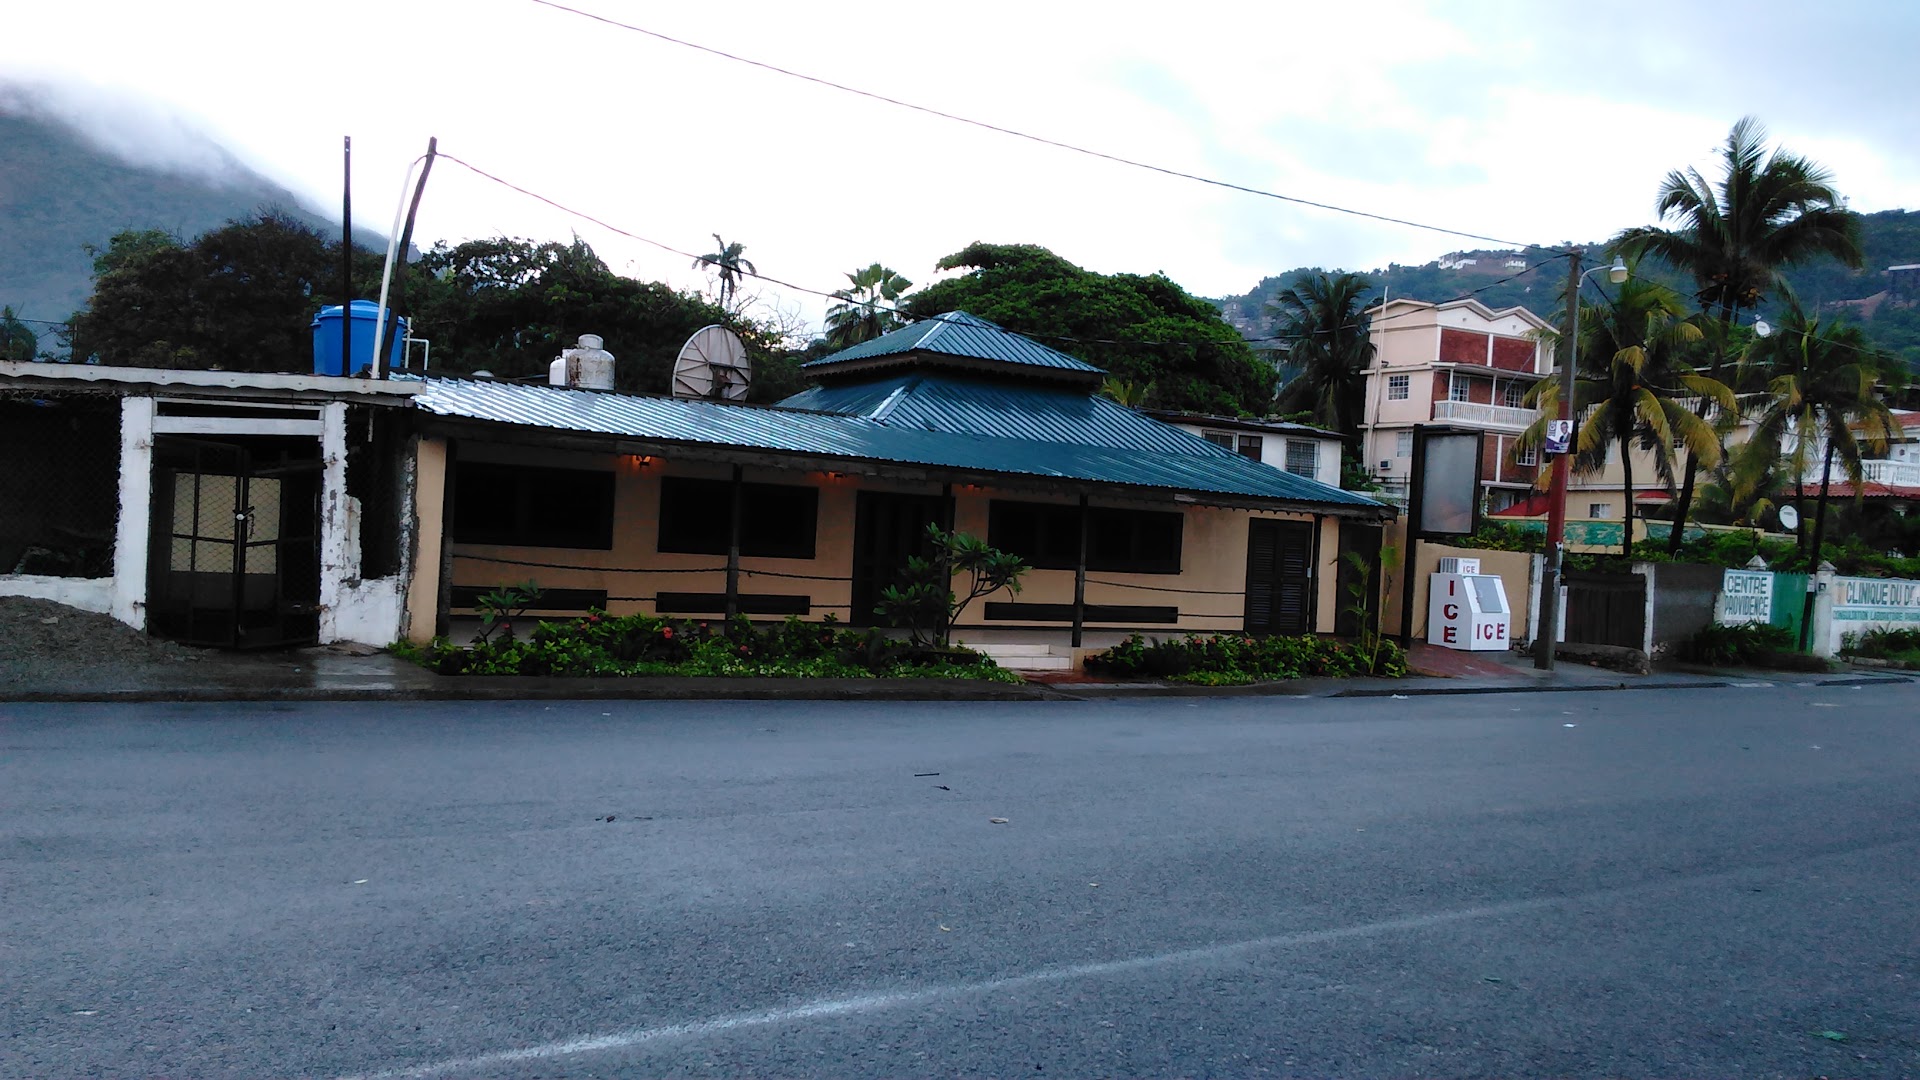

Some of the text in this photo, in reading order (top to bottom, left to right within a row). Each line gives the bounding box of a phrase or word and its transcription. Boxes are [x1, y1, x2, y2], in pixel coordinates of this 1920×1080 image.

[1727, 575, 1767, 594] CENTRE
[1846, 581, 1888, 605] CLINIQUE
[1890, 584, 1902, 605] DU
[1443, 580, 1459, 643] ICE
[1725, 595, 1769, 616] PROVIDENCE
[1476, 623, 1505, 640] ICE
